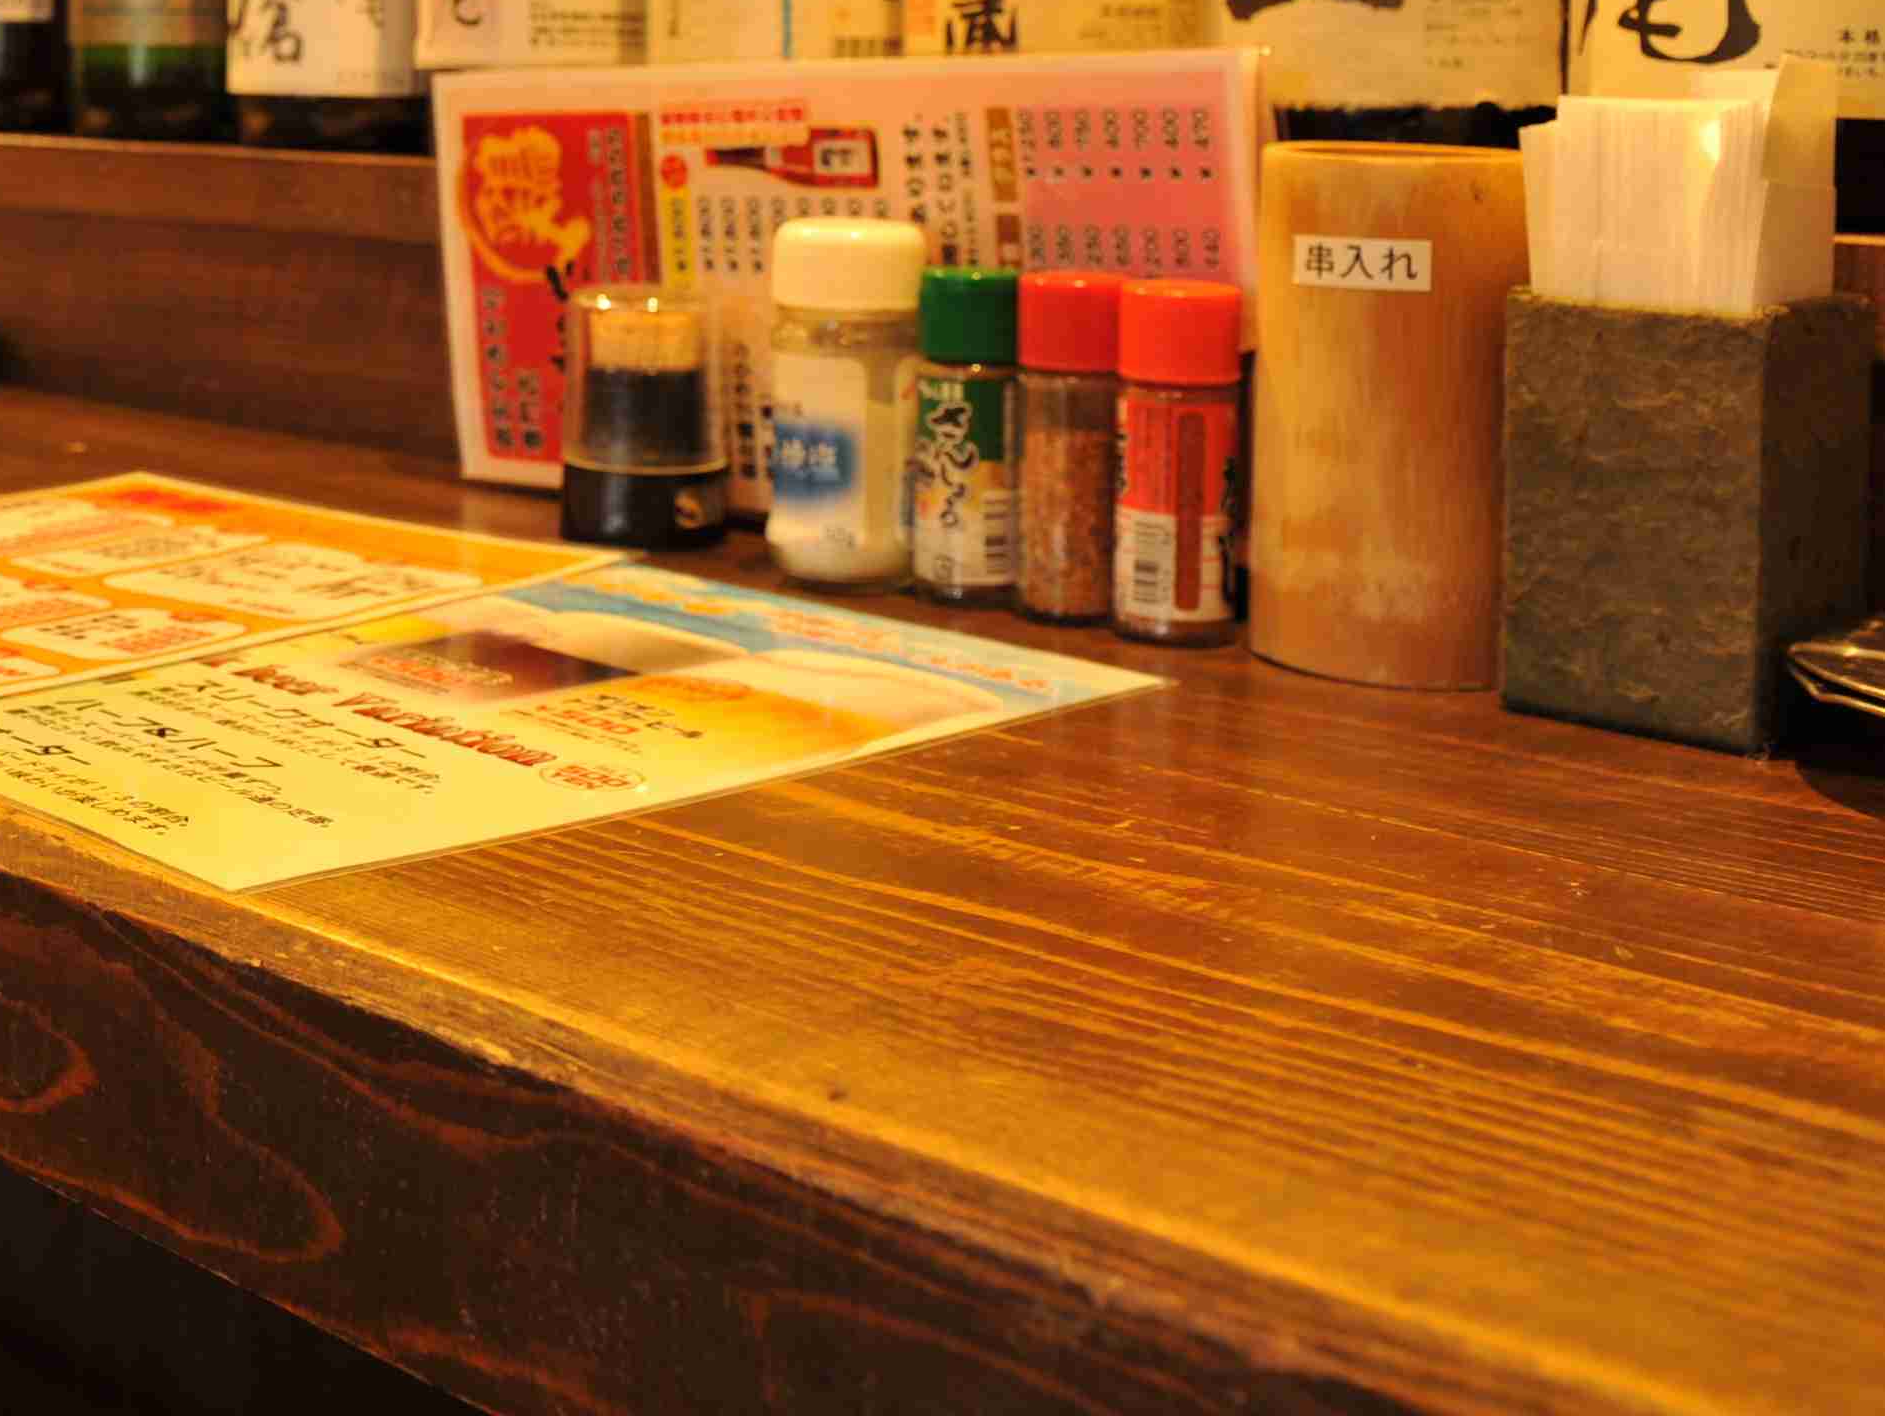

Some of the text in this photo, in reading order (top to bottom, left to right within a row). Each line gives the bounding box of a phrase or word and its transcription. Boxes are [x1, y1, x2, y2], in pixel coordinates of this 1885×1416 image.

[1305, 242, 1417, 283] 串入れ
[176, 680, 431, 759] スリークォーター
[331, 693, 559, 766] Variation
